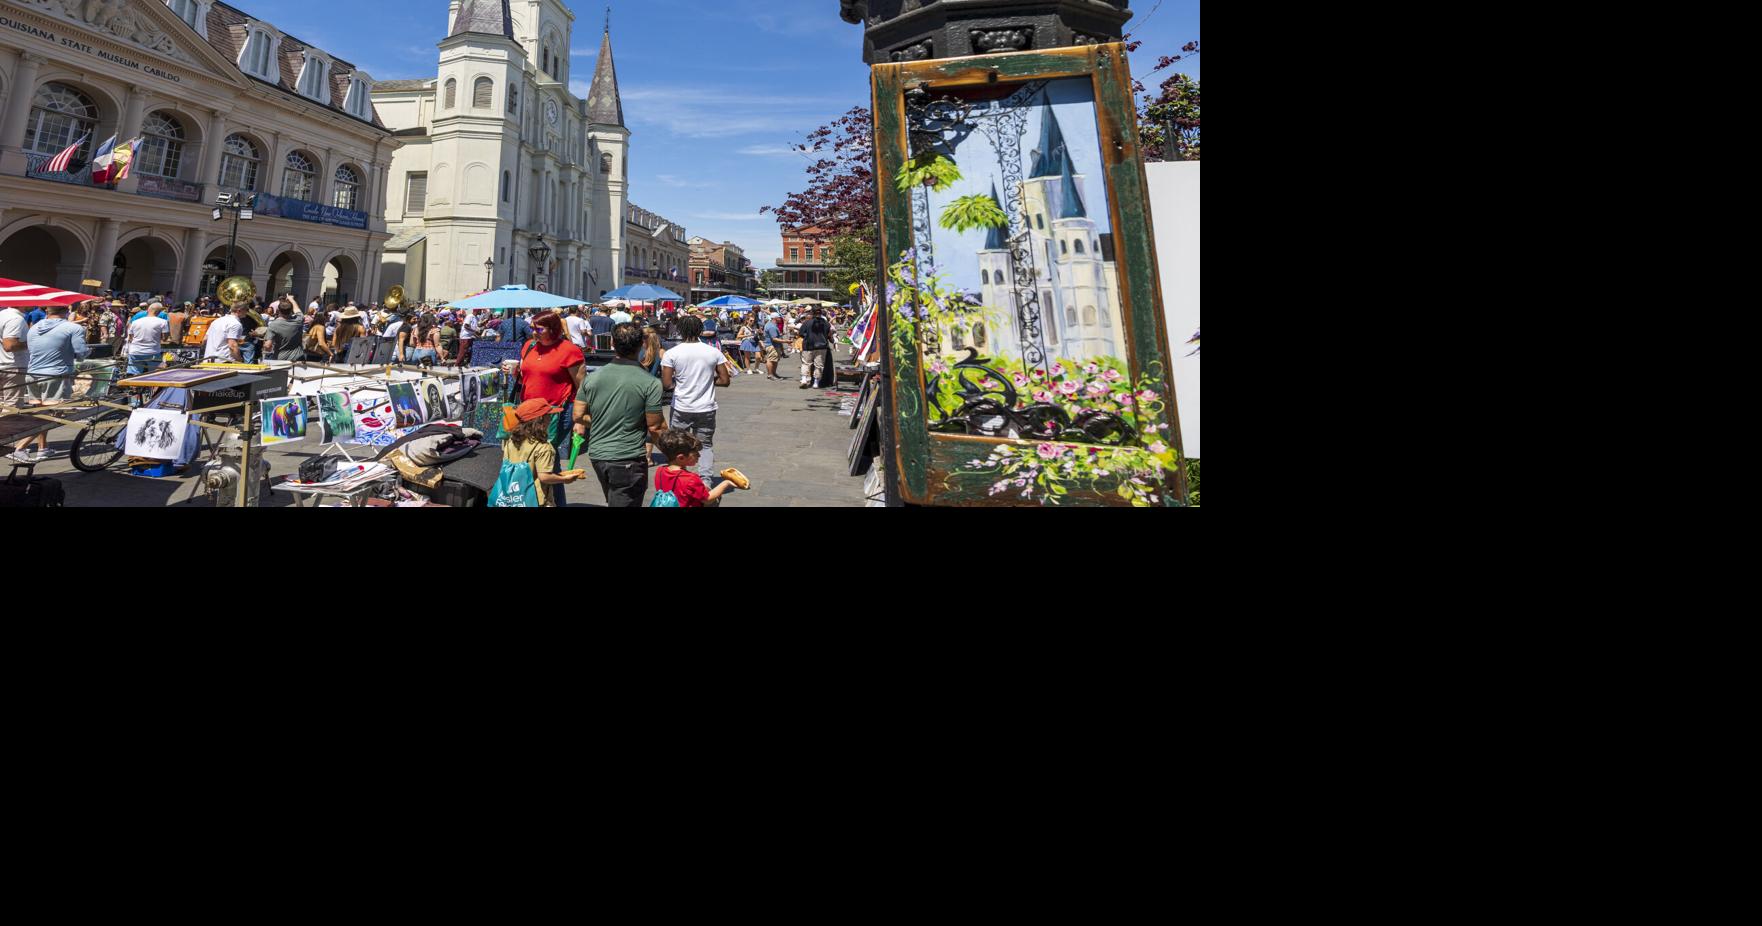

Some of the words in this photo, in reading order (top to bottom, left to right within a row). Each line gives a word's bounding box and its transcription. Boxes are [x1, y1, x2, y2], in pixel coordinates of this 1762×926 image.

[60, 38, 93, 54] STATE
[98, 50, 139, 69] MUSEUM
[144, 65, 180, 82] CABILDO
